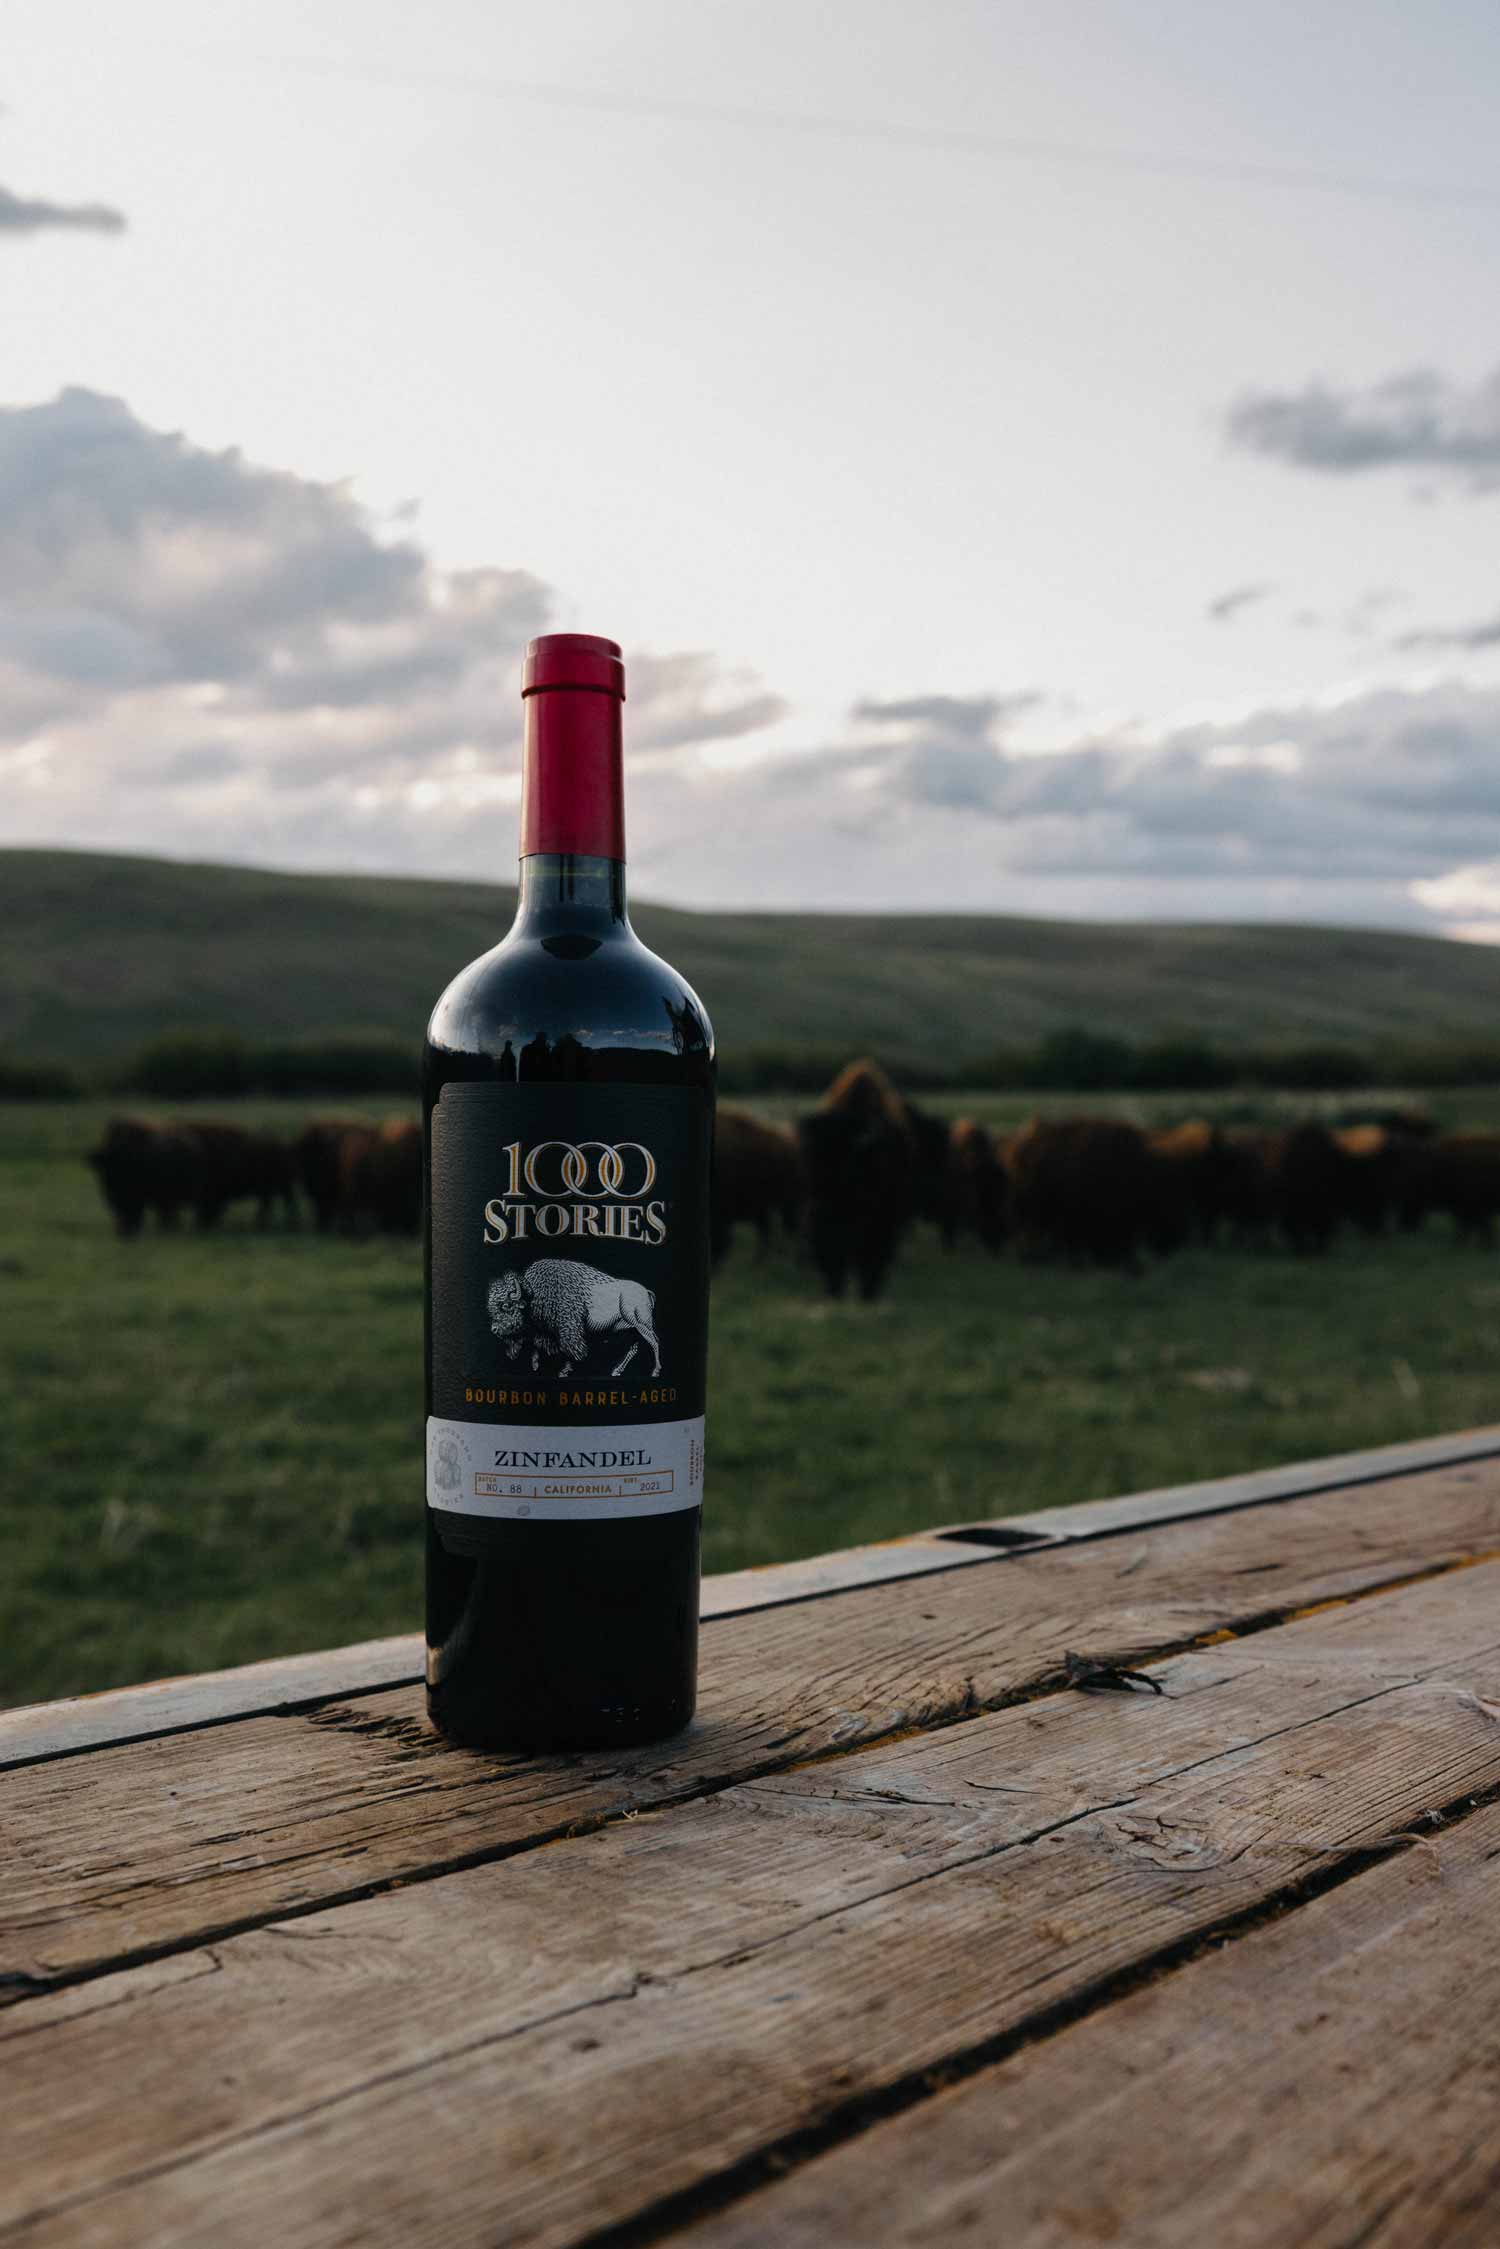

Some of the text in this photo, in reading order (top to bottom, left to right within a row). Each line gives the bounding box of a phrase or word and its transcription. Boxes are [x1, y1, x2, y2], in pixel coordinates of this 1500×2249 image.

[502, 1141, 656, 1198] 1000
[483, 1199, 667, 1245] STORIES
[465, 1388, 677, 1406] BOURBON BARREL-AGED
[494, 1450, 652, 1469] ZINFANDEL
[544, 1485, 612, 1495] CALIFORNIA
[640, 1481, 660, 1492] 2021
